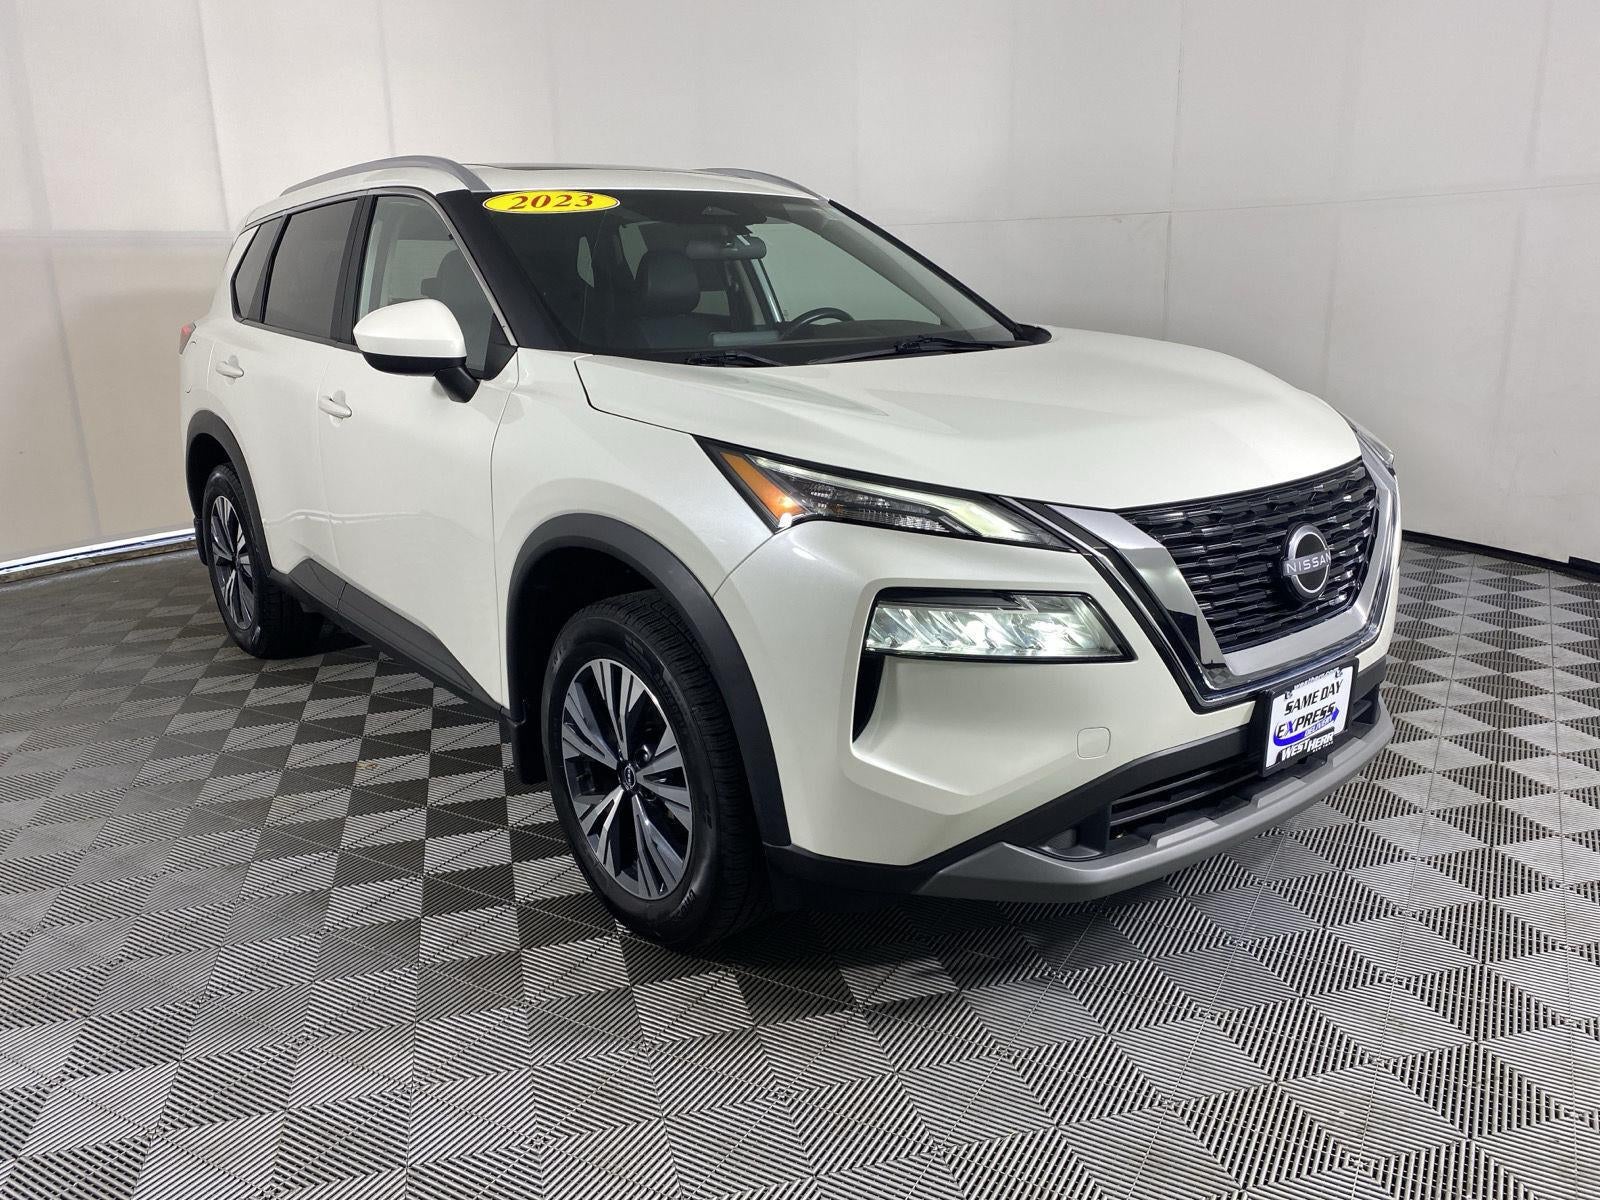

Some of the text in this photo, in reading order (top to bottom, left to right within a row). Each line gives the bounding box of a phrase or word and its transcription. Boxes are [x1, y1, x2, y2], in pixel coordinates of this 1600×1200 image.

[508, 194, 594, 210] 2023
[1286, 552, 1331, 573] NISSAN
[1284, 679, 1343, 716] SAME DAY
[1277, 702, 1336, 738] EXPRESS
